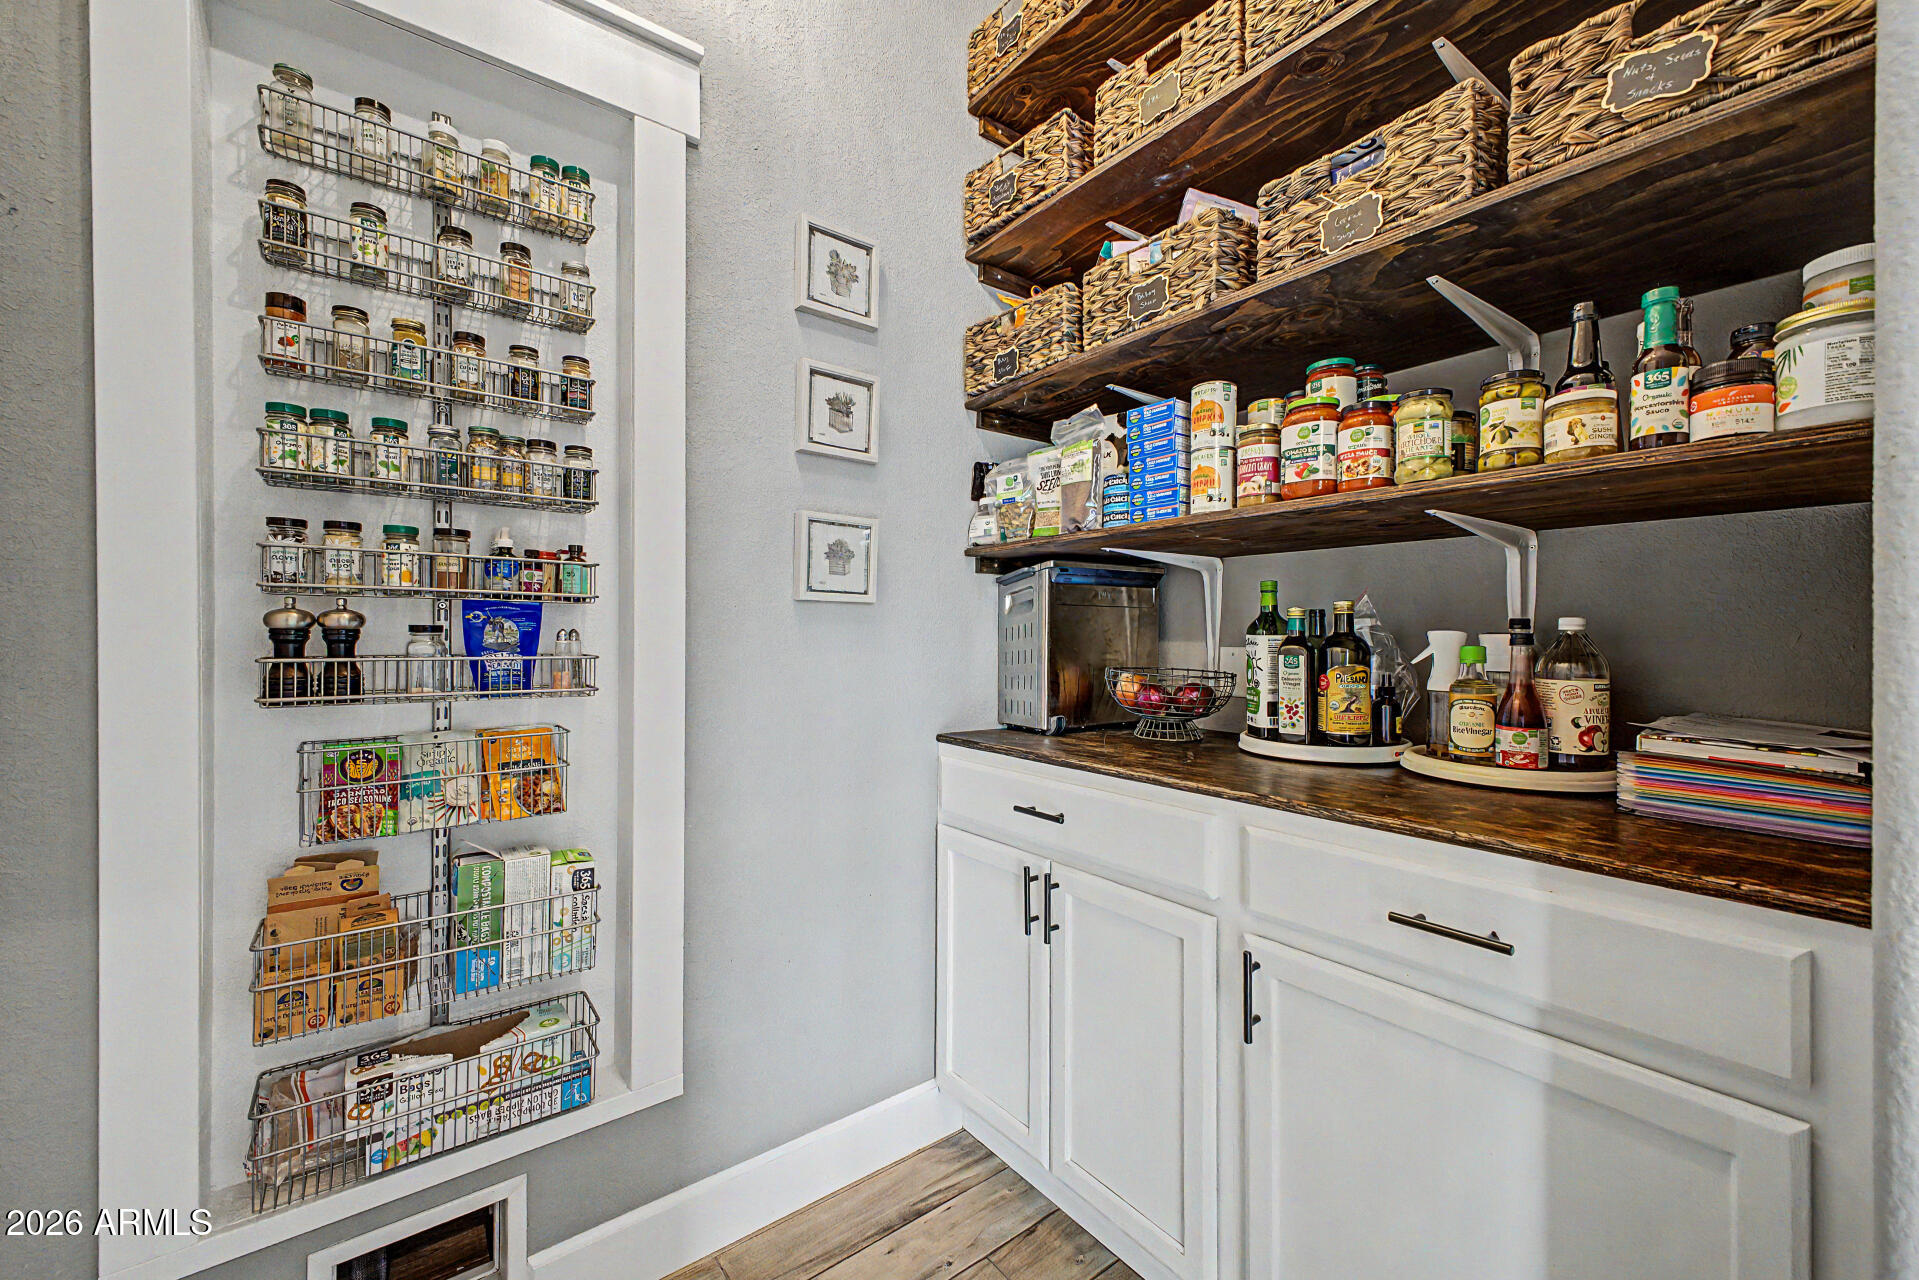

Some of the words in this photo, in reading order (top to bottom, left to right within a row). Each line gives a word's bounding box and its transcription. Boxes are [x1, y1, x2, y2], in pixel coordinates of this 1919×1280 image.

[1646, 371, 1670, 383] 365
[349, 795, 392, 804] SESONING
[580, 869, 592, 890] 365
[480, 865, 491, 919] COMPOSTALE
[400, 1092, 426, 1103] Gllon
